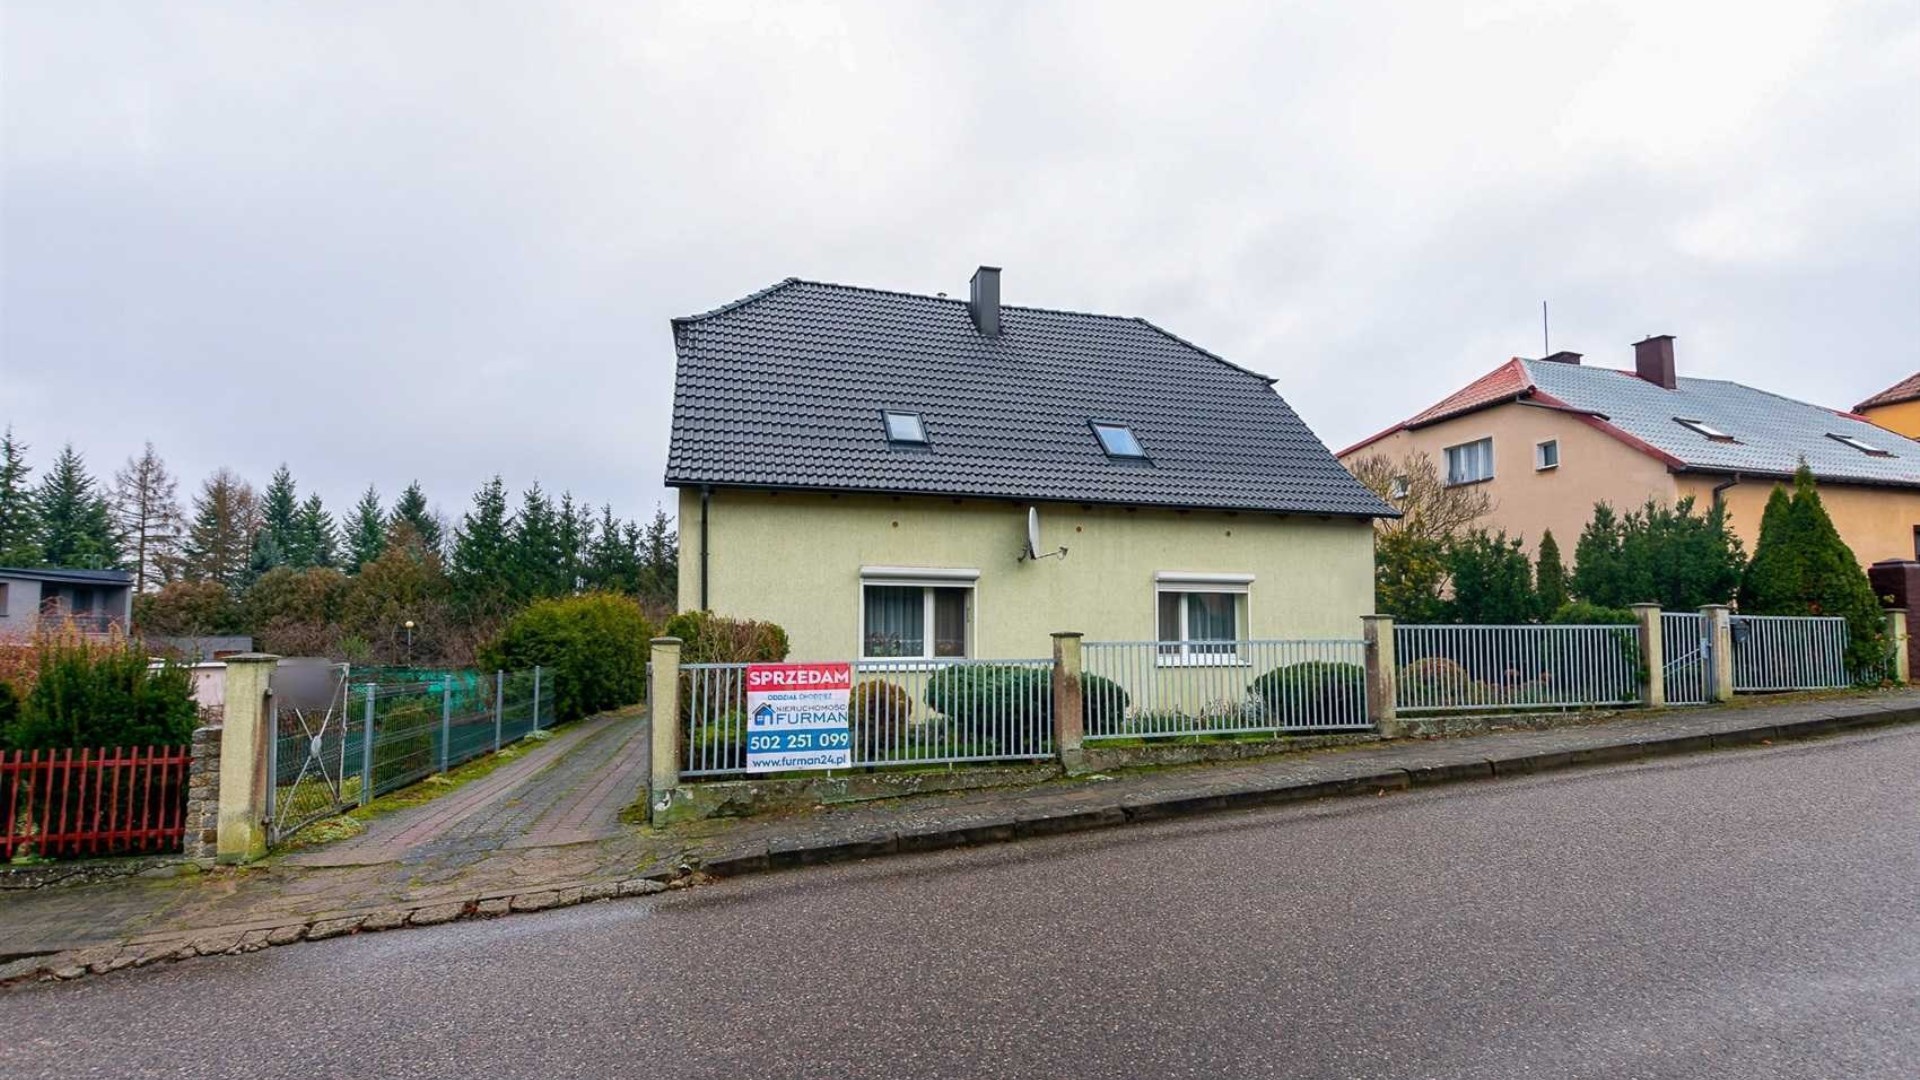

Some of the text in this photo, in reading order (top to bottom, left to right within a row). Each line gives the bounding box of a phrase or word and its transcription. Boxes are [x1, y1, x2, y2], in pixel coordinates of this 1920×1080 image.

[749, 670, 849, 686] SPRZEDAM
[776, 712, 848, 725] FURMAN
[750, 732, 849, 750] 502 251 099
[752, 754, 846, 767] www.furman24.pl
